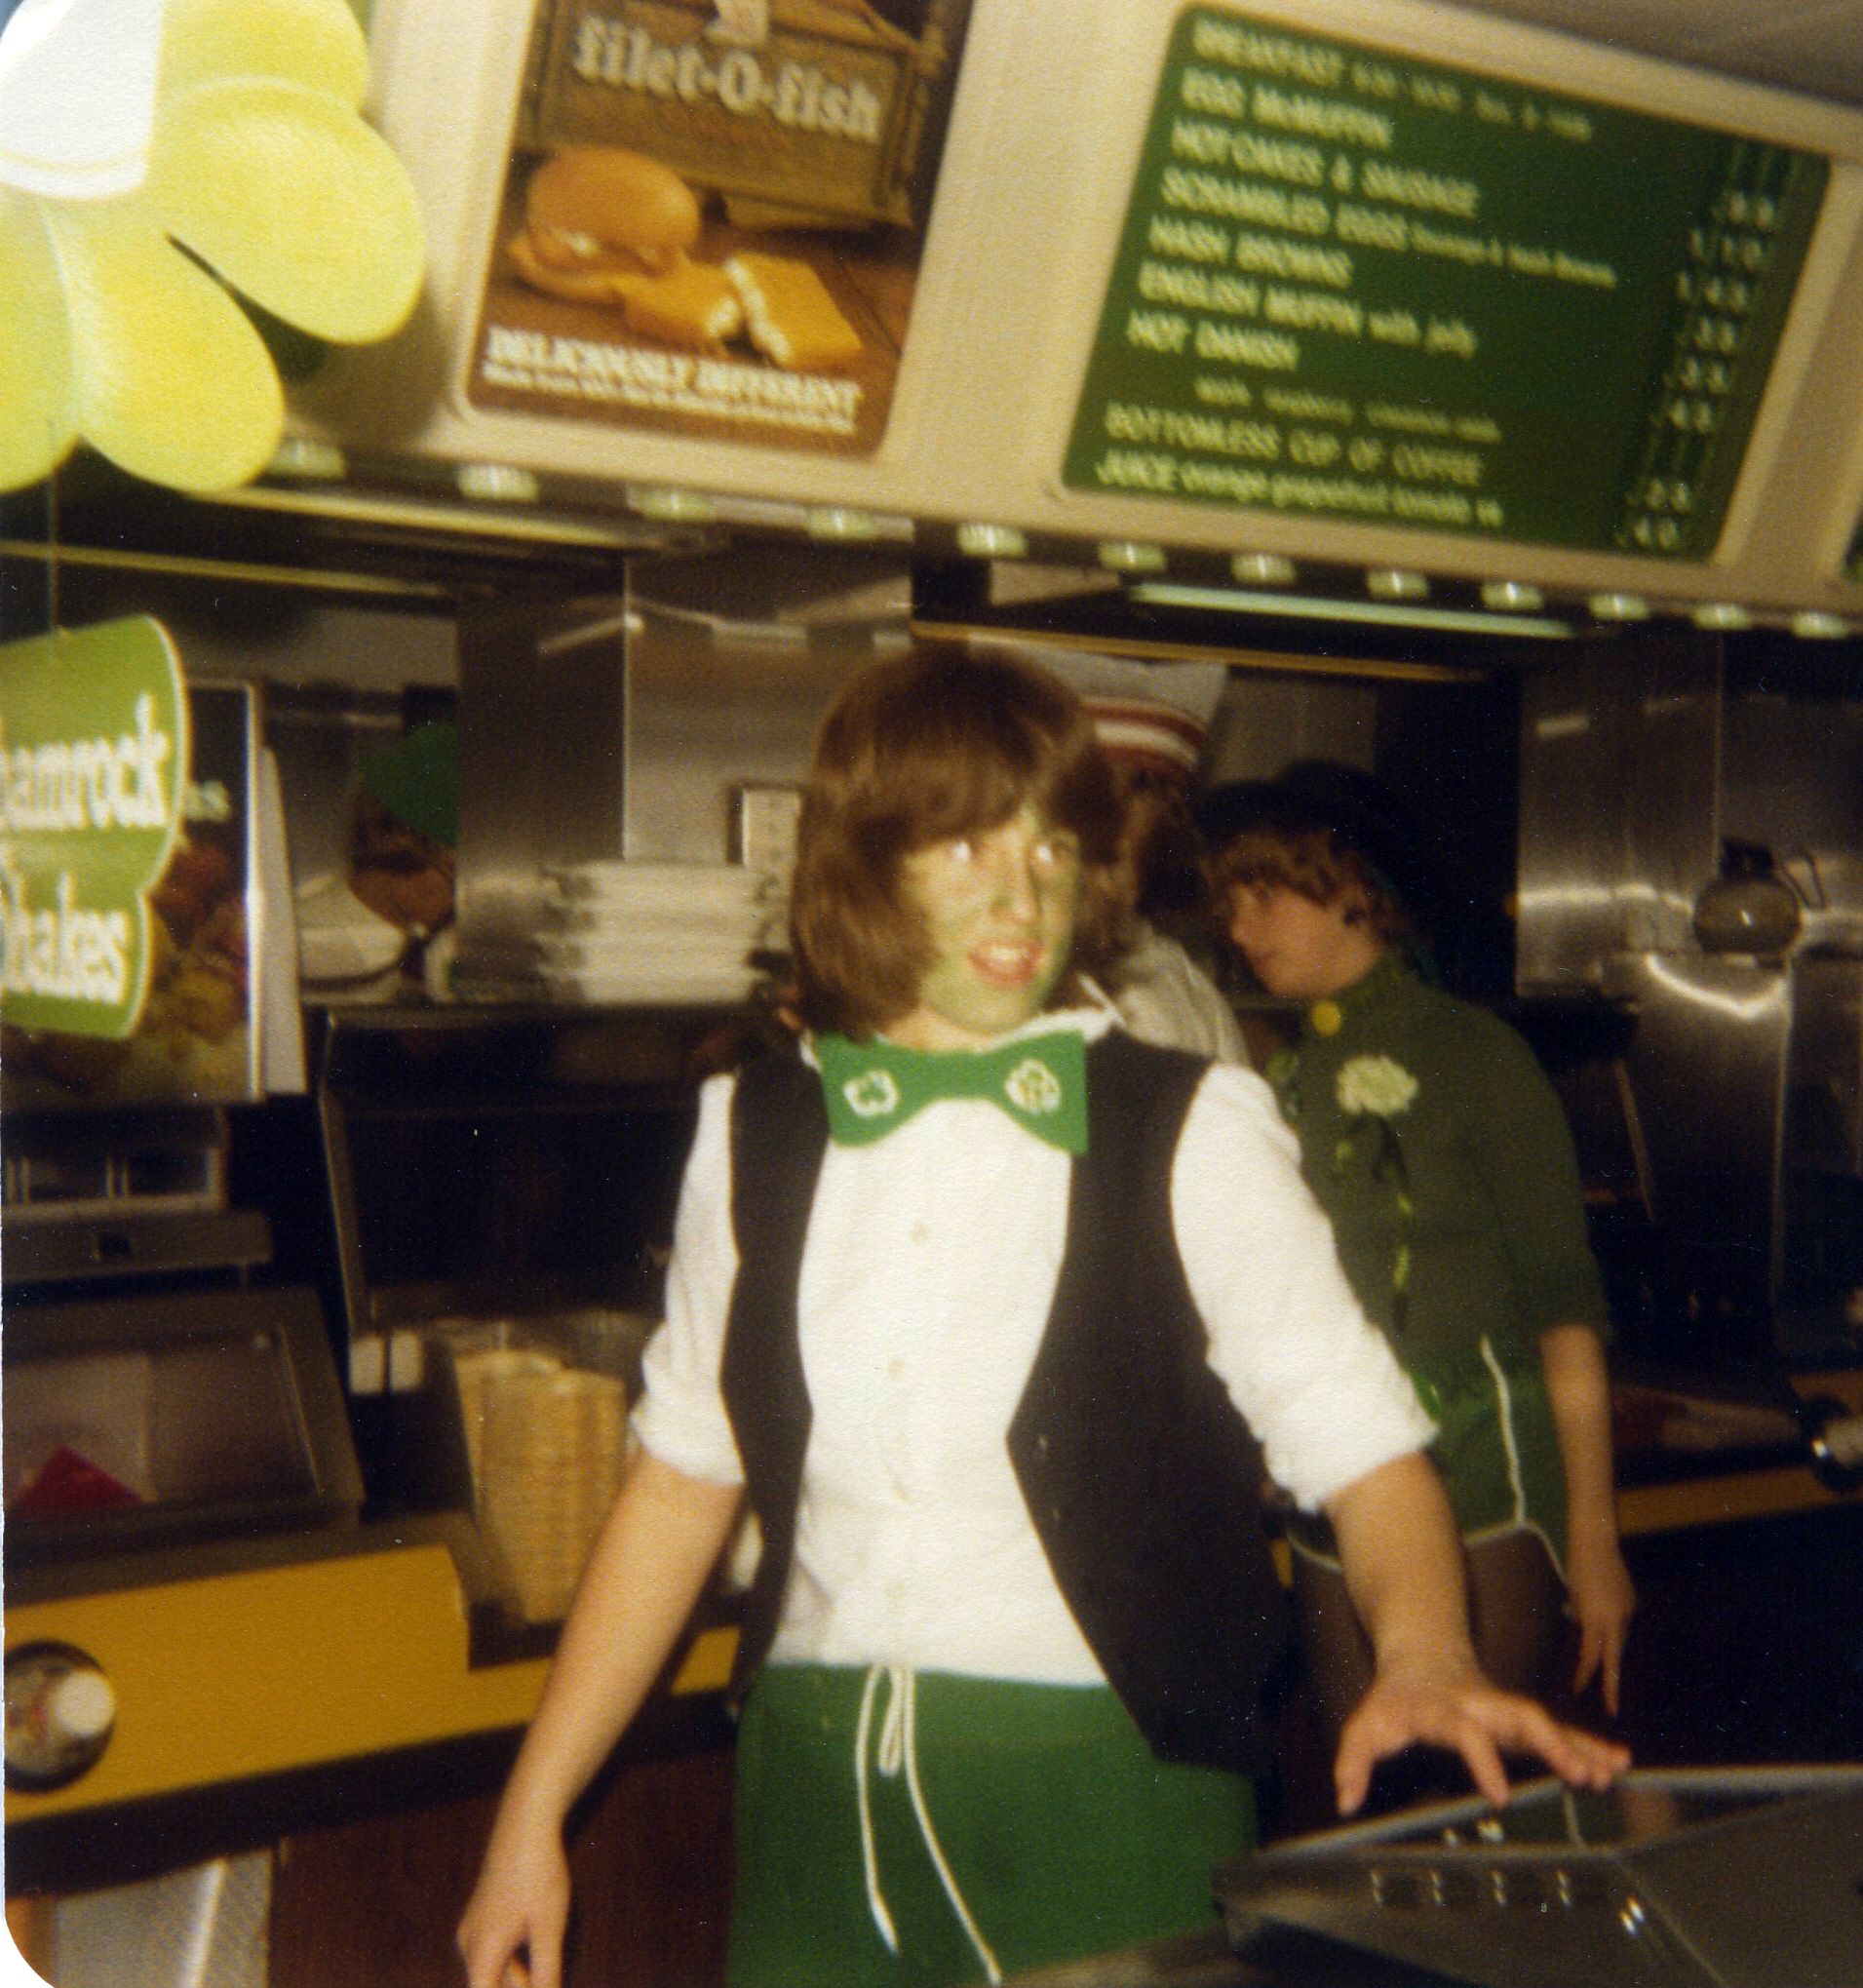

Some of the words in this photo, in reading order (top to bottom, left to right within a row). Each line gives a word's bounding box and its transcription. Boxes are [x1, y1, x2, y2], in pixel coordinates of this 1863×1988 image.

[1180, 69, 1247, 116] EGG
[1148, 217, 1228, 262] HASH
[1235, 235, 1353, 286] BROWNS
[1334, 204, 1411, 250] EGGS
[1139, 262, 1260, 314] ENGLISH
[1263, 287, 1364, 334] MUFFIN
[1127, 311, 1188, 350] HOT
[1194, 324, 1300, 369] DANISH
[1095, 449, 1178, 489] JUICE
[1104, 404, 1281, 457] BOTTOMLESS
[1287, 430, 1339, 465] CUP
[1346, 439, 1384, 471] OF
[1390, 445, 1483, 485] COFFEE
